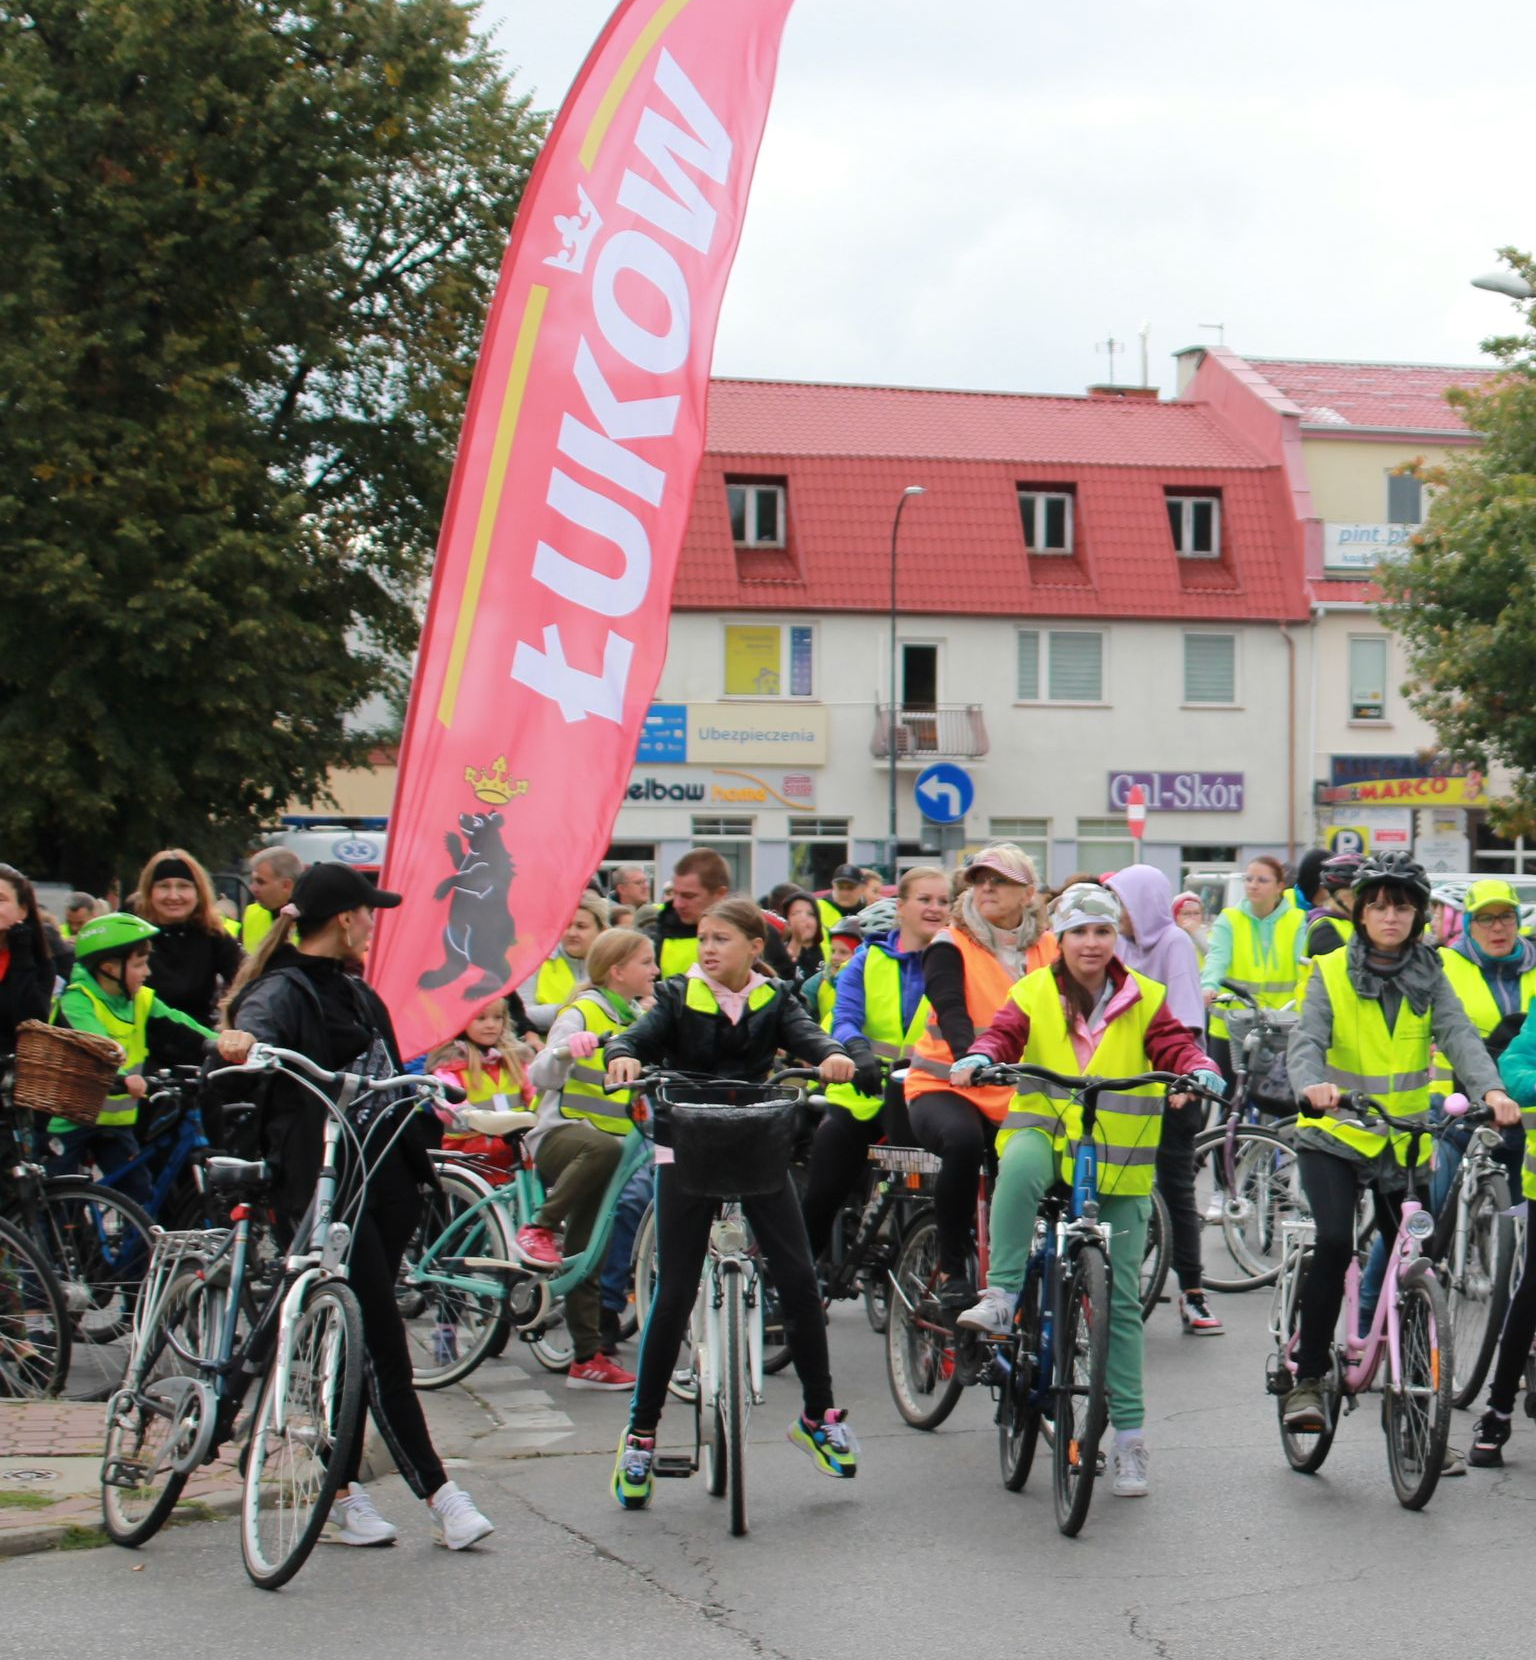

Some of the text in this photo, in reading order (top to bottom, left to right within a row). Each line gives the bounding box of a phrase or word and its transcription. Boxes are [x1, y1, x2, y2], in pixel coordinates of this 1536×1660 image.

[699, 727, 815, 743] Ubezpieczenia
[625, 777, 705, 801] elbaw
[711, 783, 768, 803] home
[1110, 773, 1243, 808] Gal-Skór
[1359, 775, 1448, 801] MARCO
